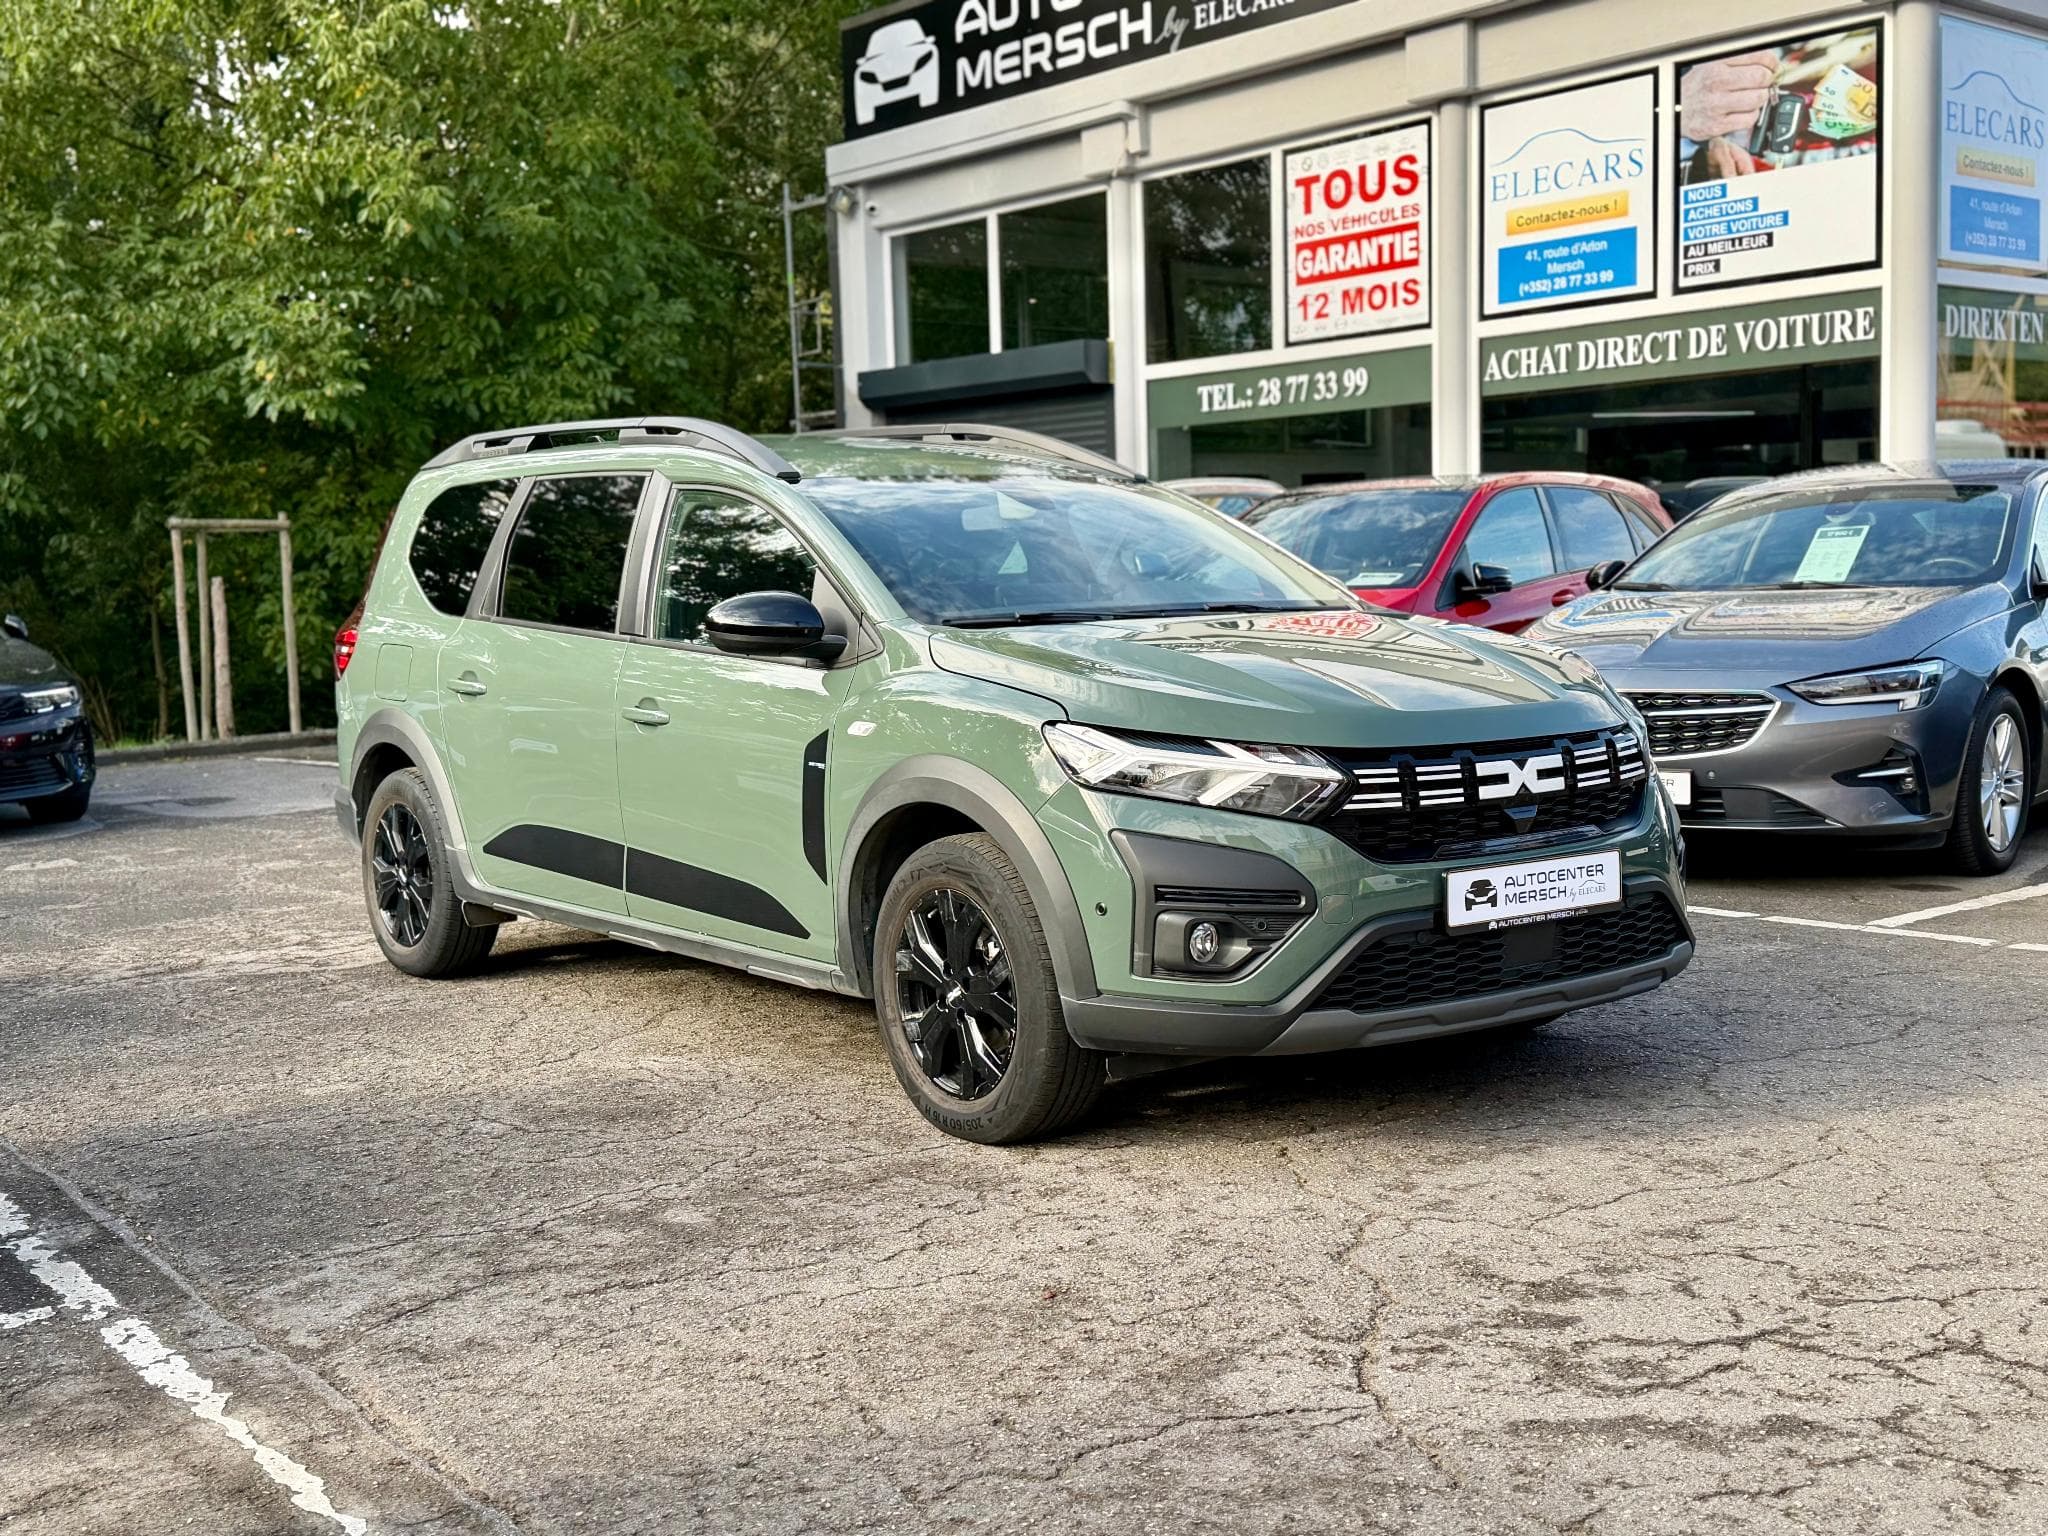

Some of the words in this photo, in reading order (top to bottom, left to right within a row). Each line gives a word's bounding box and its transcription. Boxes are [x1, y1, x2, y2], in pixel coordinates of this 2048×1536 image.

[956, 1, 1152, 97] MERSCH
[1154, 5, 1190, 53] by
[1946, 101, 2044, 150] ELECARS
[1491, 148, 1646, 202] ELECARS
[1962, 154, 2025, 177] Contactez-nous
[1295, 154, 1420, 216] TOUS
[1687, 186, 1722, 203] NOUS
[1516, 202, 1610, 227] Contactez-nous
[1687, 199, 1754, 221] ACHETONS
[1295, 220, 1325, 239] NOS
[1687, 222, 1728, 240] VOTRE
[1730, 213, 1784, 233] VOITURE
[1297, 229, 1418, 278] GARANTIE
[1543, 246, 1570, 259] route
[1687, 245, 1705, 258] AU
[1707, 234, 1768, 254] MEILLEUR
[1547, 259, 1585, 275] Mersch
[1568, 274, 1583, 287] 77
[1584, 271, 1598, 285] 33
[1687, 262, 1716, 277] PRIX
[1298, 292, 1329, 321] 12
[1342, 278, 1420, 316] MOIS
[1945, 303, 2045, 344] DIREKTEN
[1484, 343, 1572, 382] ACHAT
[1576, 329, 1682, 371] DIRECT
[1687, 323, 1728, 360] DE
[1733, 306, 1875, 353] VOITURE
[1197, 382, 1253, 412] TEL.:
[1257, 377, 1282, 406] 28
[1285, 374, 1310, 404] 77
[1313, 370, 1338, 400] 33
[1343, 366, 1369, 397] 99
[1504, 863, 1604, 889] AUTOCENTER
[1504, 886, 1567, 906] MERSCH
[1498, 914, 1546, 928] AUTOCENTER
[1546, 910, 1574, 921] MERSCH
[949, 1117, 985, 1131] 205/60
